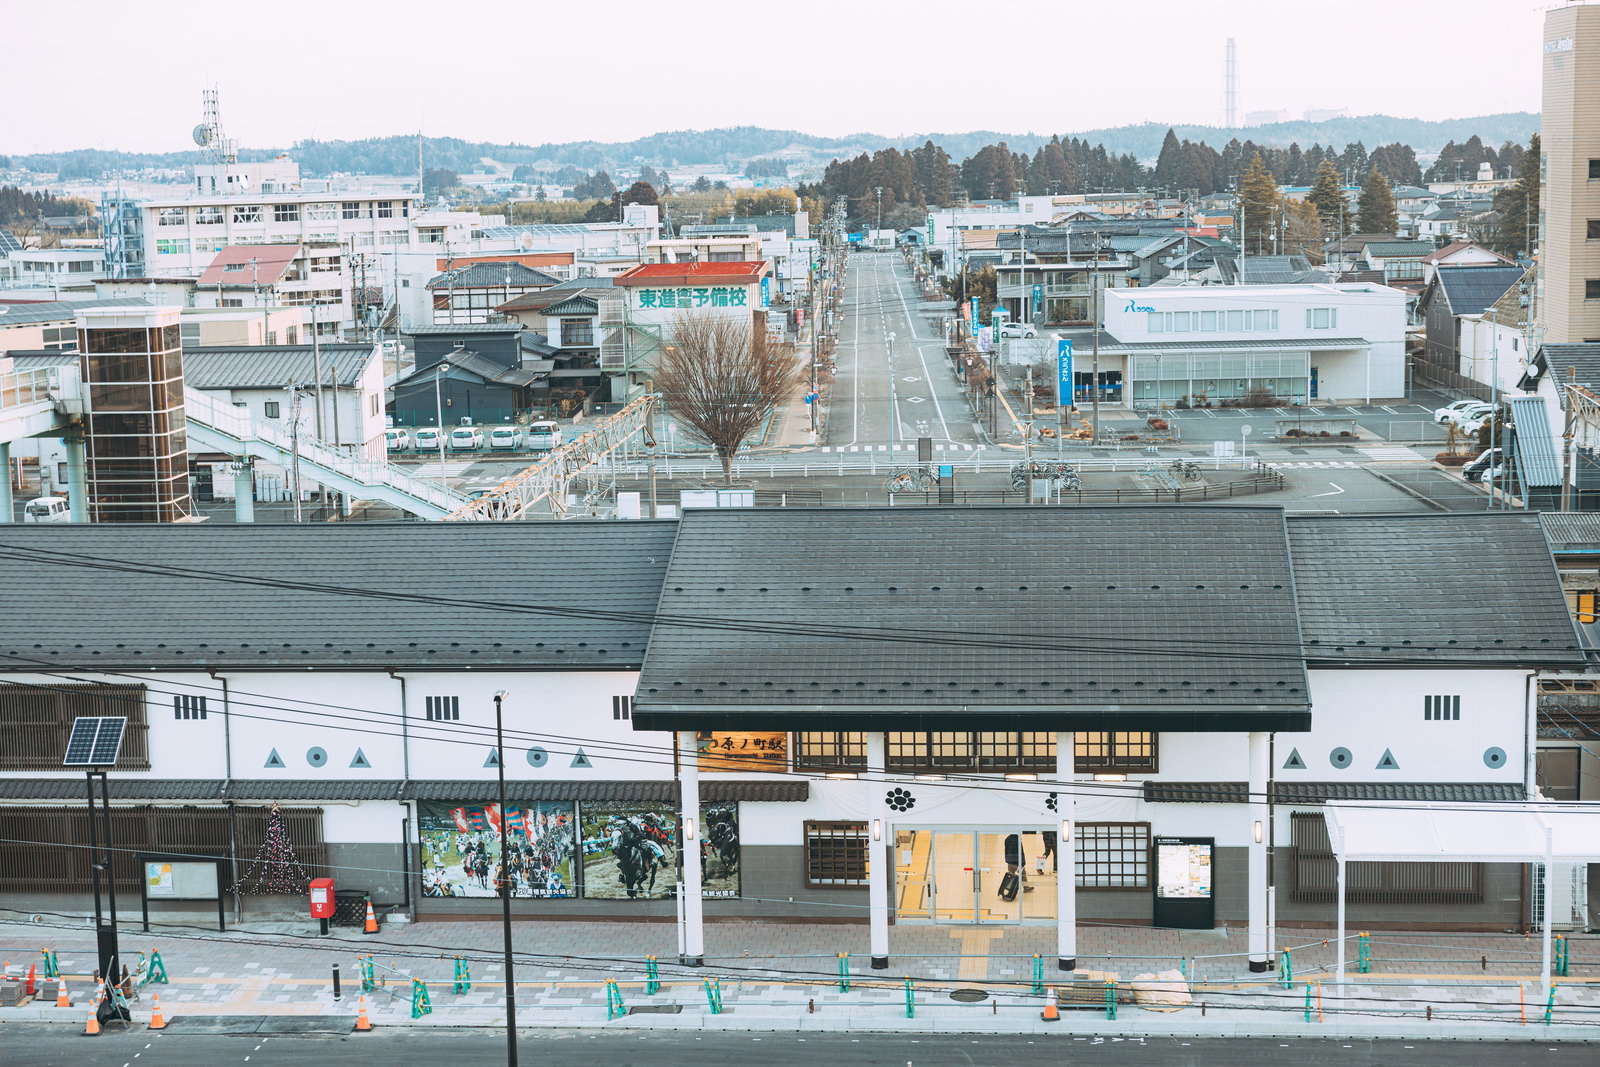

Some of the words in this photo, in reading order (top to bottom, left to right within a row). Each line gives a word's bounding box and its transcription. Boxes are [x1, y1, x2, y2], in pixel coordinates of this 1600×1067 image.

[639, 287, 747, 308] 東進衛星予備校
